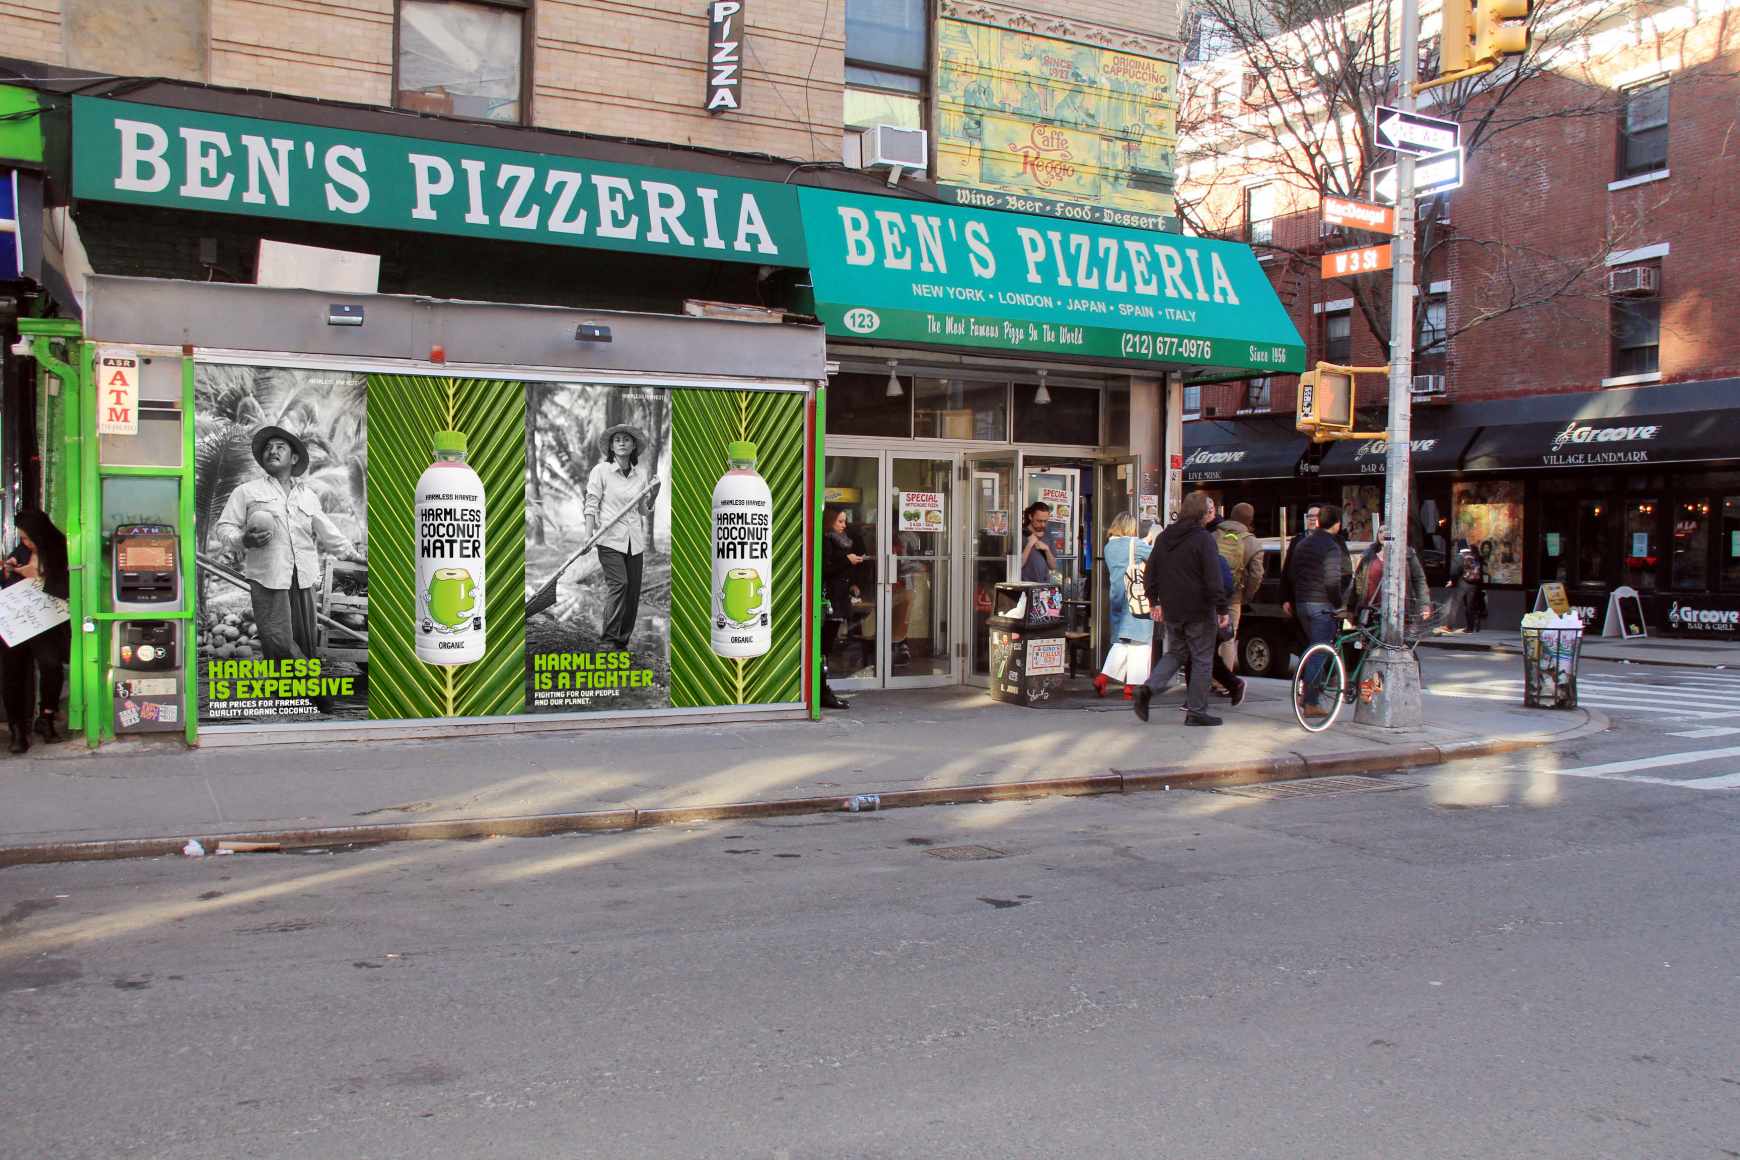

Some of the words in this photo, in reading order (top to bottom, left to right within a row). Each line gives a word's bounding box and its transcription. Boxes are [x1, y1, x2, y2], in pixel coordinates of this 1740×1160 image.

[708, 2, 741, 110] PIZZA
[1113, 55, 1158, 74] ORIGINAL
[1103, 63, 1167, 85] CAPPUCCINO
[1008, 143, 1075, 187] Reggio
[114, 118, 371, 214] BEN'S
[408, 153, 779, 255] PIZZERIA
[1006, 195, 1042, 212] Beer
[1055, 202, 1092, 220] Food
[1103, 208, 1166, 230] Dessert
[836, 206, 996, 280] BEN'S
[1016, 226, 1241, 305] PIZZERIA
[1335, 254, 1347, 273] W
[1350, 253, 1360, 270] 3
[911, 283, 944, 298] NEW
[945, 286, 985, 302] YORK
[999, 292, 1053, 309] LONDON
[1067, 298, 1107, 314] JAPAN
[1118, 303, 1154, 319] SPAIN
[1165, 308, 1197, 323] ITALY
[850, 312, 874, 329] 123
[927, 314, 941, 334] The
[945, 315, 965, 335] Most
[970, 317, 999, 338] Famous
[1003, 320, 1025, 344] Pizza
[1028, 323, 1038, 341] In
[1043, 324, 1056, 343] The
[1059, 325, 1084, 345] World
[1121, 332, 1153, 359] (212)
[1156, 336, 1212, 360] 677-0976
[1249, 345, 1268, 362] Since
[1271, 347, 1286, 363] 1956
[107, 370, 130, 423] ATM
[1571, 426, 1658, 443] Groove
[1194, 450, 1247, 464] Groove
[1543, 453, 1585, 465] VILLAGE
[1588, 450, 1648, 464] LANDMARK
[1361, 463, 1377, 473] BAR
[905, 493, 939, 503] SPECIAL
[1043, 488, 1068, 499] SPECIAL
[421, 508, 481, 522] HARMLESS
[716, 512, 769, 526] HARMLESS
[131, 527, 160, 535] ATM
[421, 523, 481, 538] COCONUT
[716, 526, 769, 541] COCONUT
[421, 539, 481, 559] WATER
[716, 541, 768, 559] WATER
[1679, 606, 1739, 624] Groove
[438, 641, 465, 650] ORGANIC
[730, 635, 753, 644] ORGANIC
[208, 658, 321, 679] HARMLESS
[534, 651, 631, 671] HARMLESS
[209, 681, 231, 700] IS
[236, 677, 354, 699] EXPENSIVE
[534, 672, 552, 690] IS
[558, 671, 571, 689] A
[575, 669, 654, 689] FIGHTER
[534, 691, 565, 699] FIGHTING
[580, 690, 594, 698] OUR
[595, 689, 620, 697] PEOPLE
[564, 697, 592, 705] PLANET.
[209, 701, 227, 709] FAIR
[229, 700, 257, 708] PRICES
[275, 698, 313, 706] FARMERS.
[209, 709, 242, 717] QUALITY
[243, 708, 278, 716] ORGANIC
[278, 706, 321, 714] COCONUTS.
